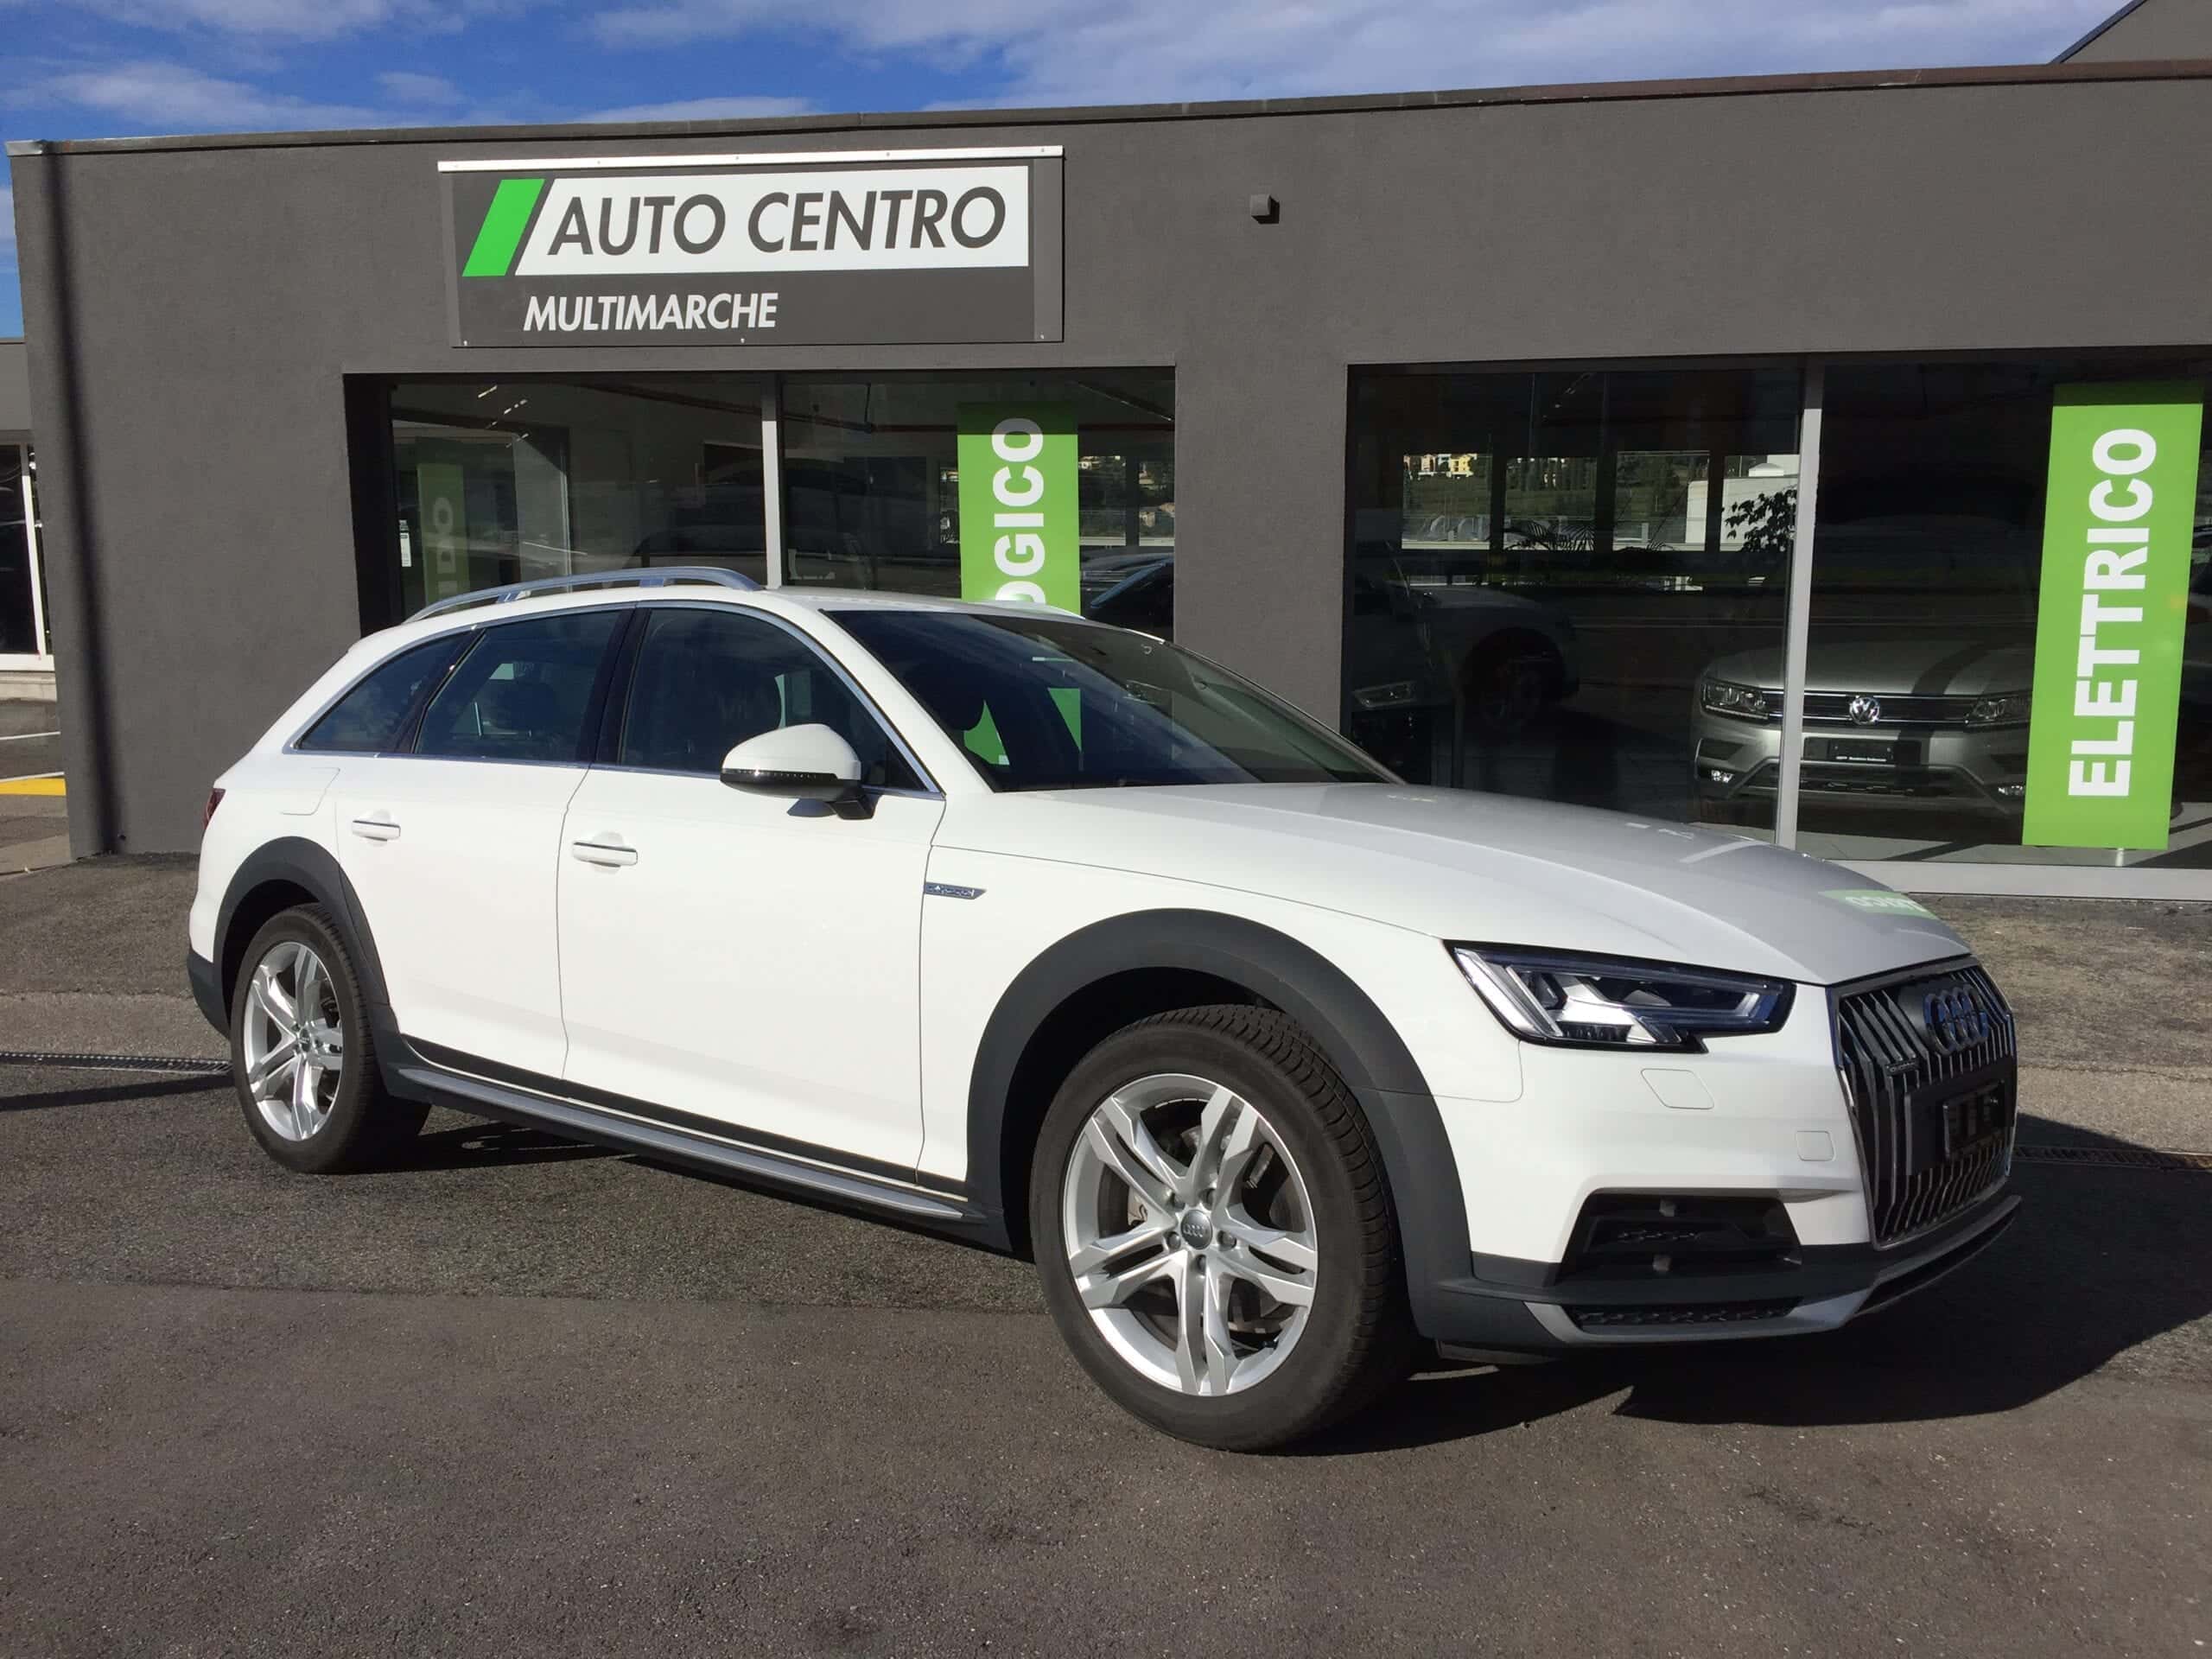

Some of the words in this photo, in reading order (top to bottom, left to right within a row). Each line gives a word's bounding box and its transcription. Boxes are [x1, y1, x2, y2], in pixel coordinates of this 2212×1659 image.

[547, 194, 727, 255] AUTO
[747, 186, 1006, 252] CENTRO
[524, 293, 779, 332] MULTIMARCHE
[2068, 429, 2157, 797] ELETTRICO
